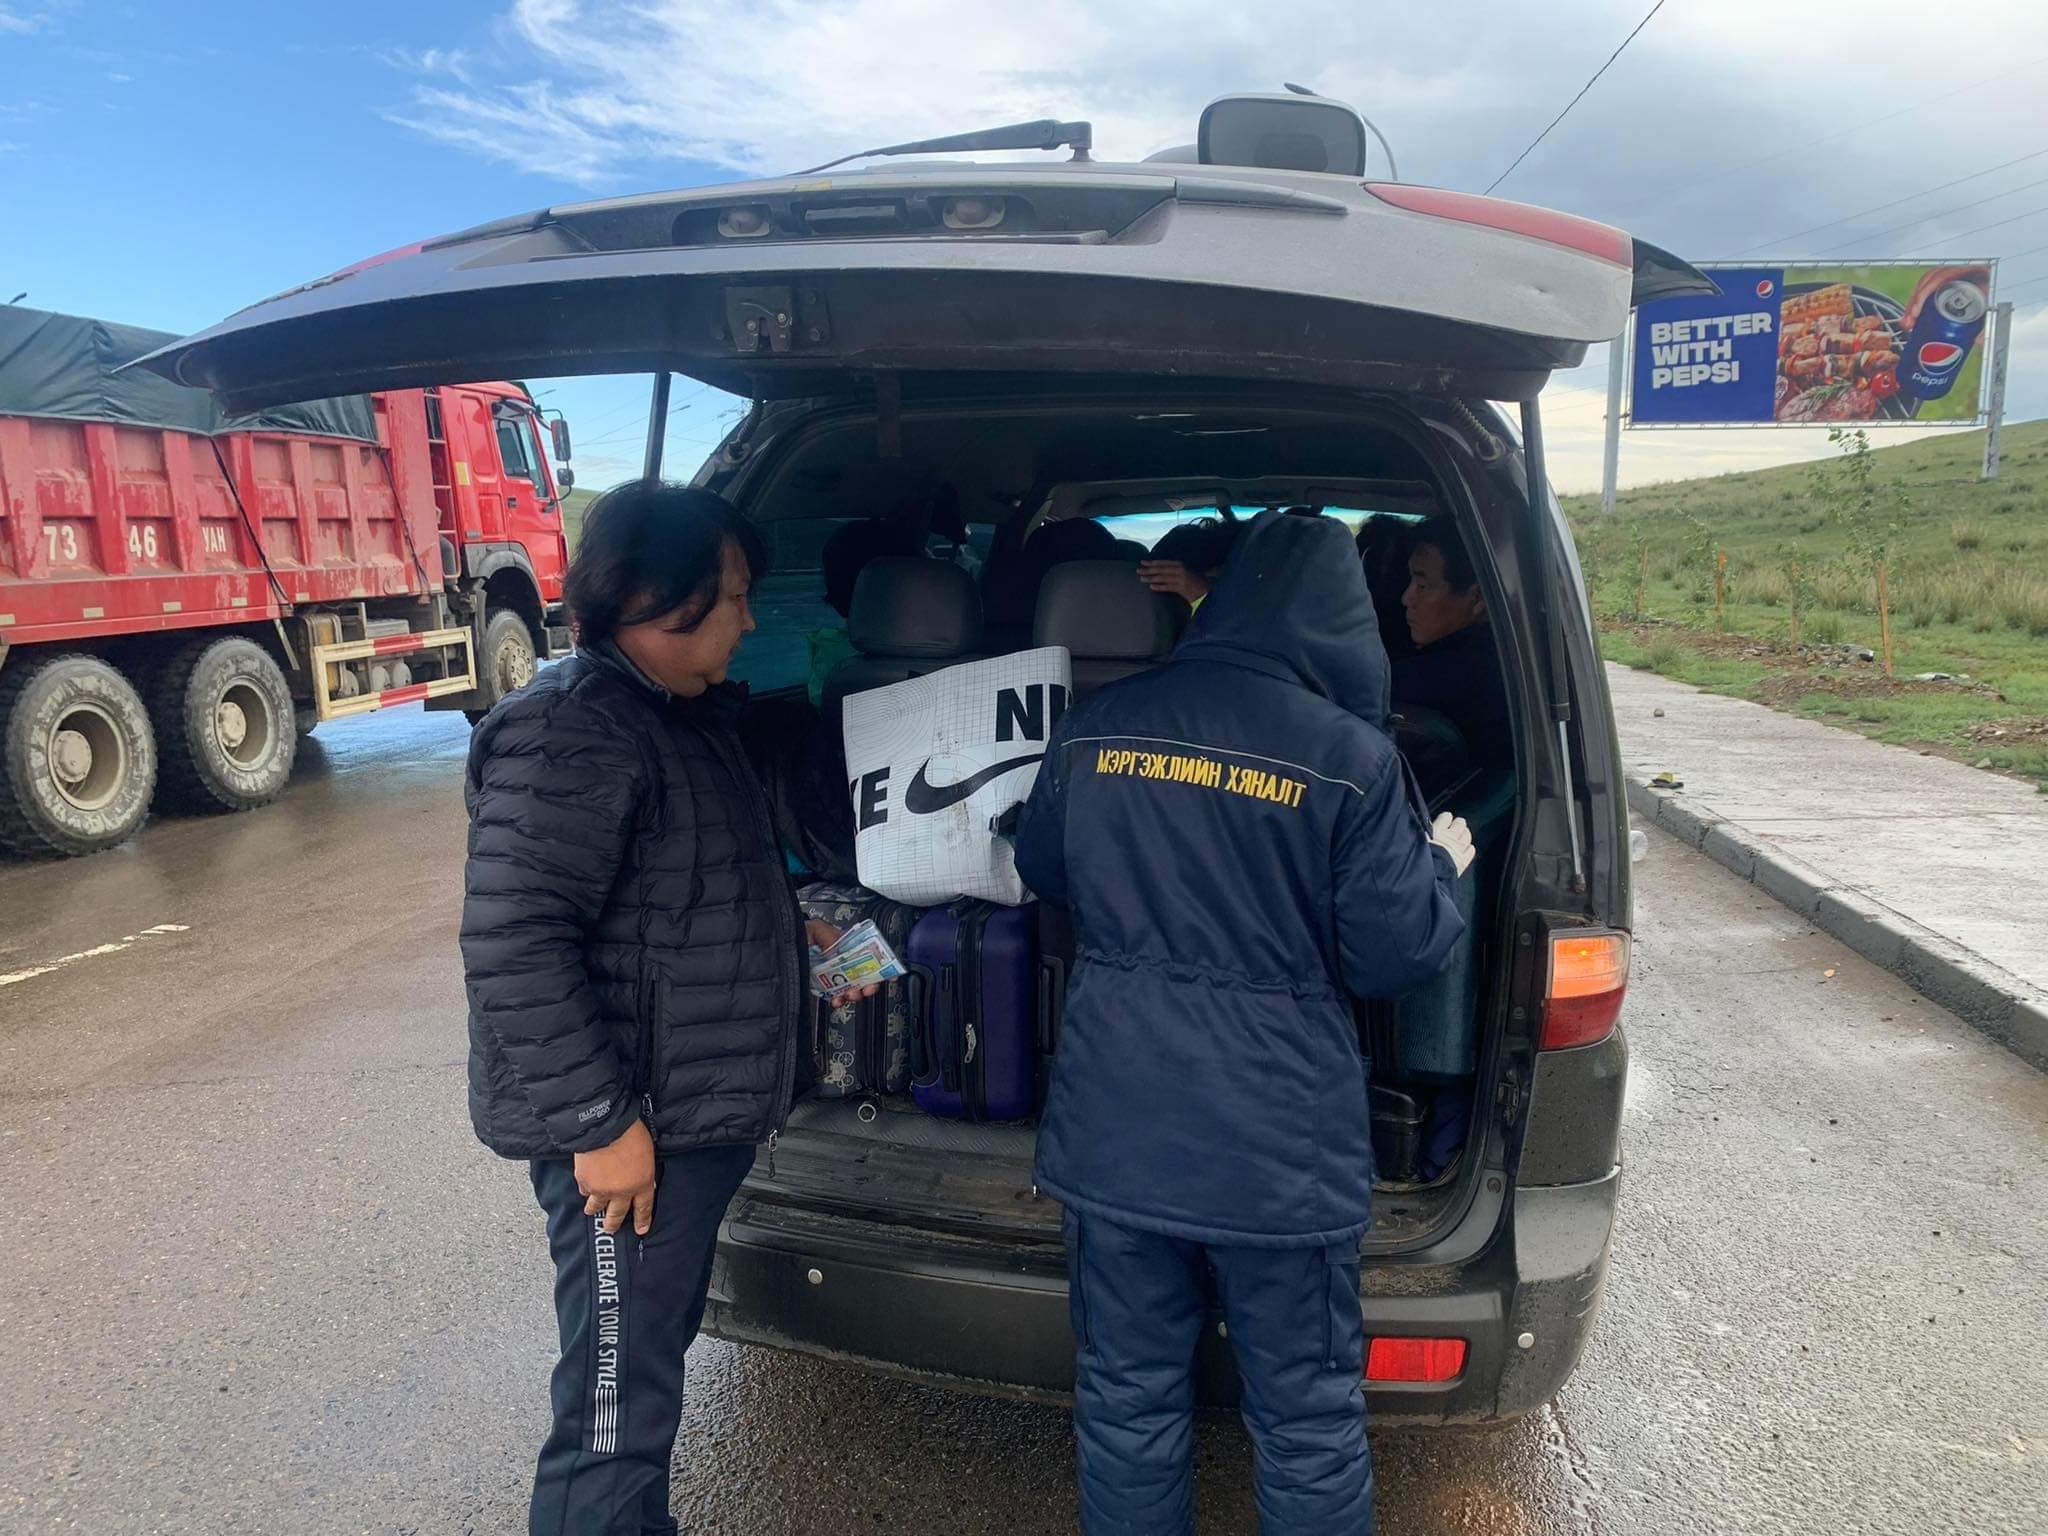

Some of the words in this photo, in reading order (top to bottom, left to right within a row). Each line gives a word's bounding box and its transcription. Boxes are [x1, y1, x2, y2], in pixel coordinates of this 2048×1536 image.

[1651, 312, 1772, 344] BETTER
[1652, 339, 1732, 366] WITH
[1652, 360, 1740, 389] PEPSI
[1912, 372, 1948, 386] pepsi
[43, 525, 78, 561] 73
[128, 525, 157, 558] 46
[996, 684, 1067, 741] NI
[1096, 749, 1222, 788] МЭРГЭЖЛИЙН
[1224, 765, 1307, 807] ХЯНАЛТ
[850, 766, 890, 833] E
[598, 1306, 619, 1346] YOUR
[598, 1348, 617, 1389] STYLE
